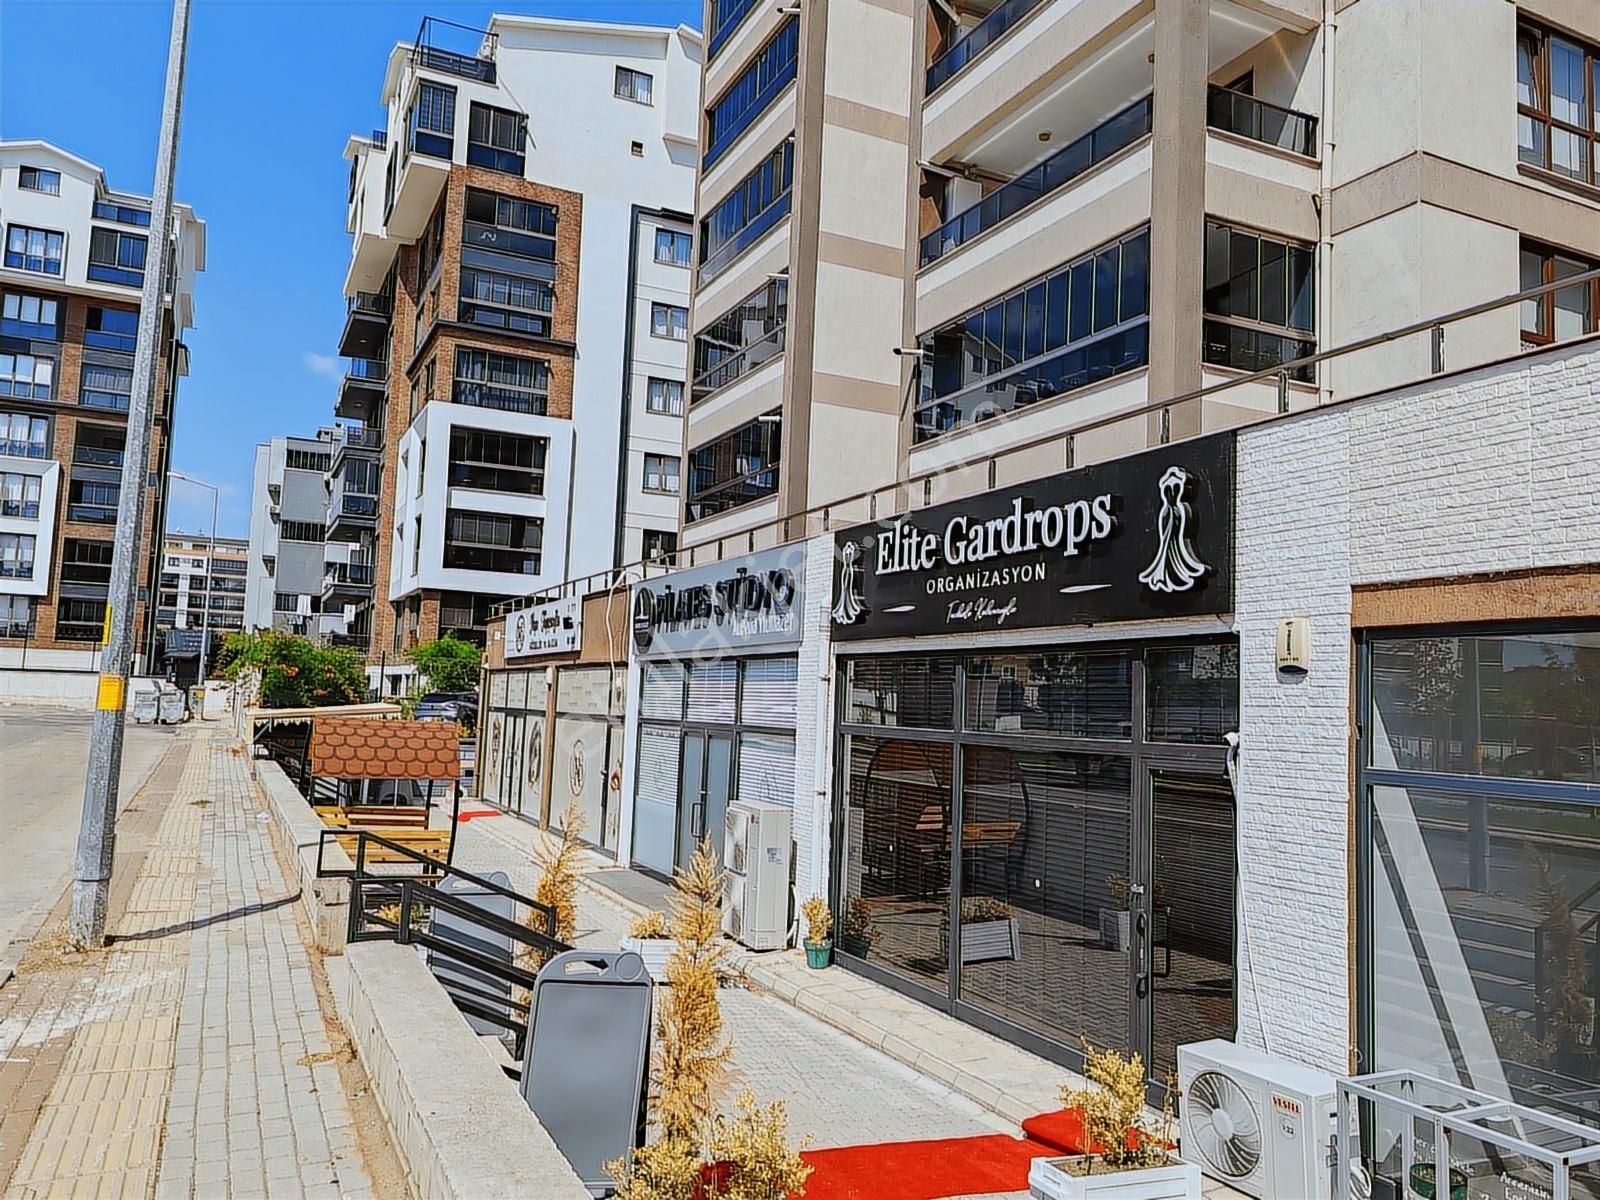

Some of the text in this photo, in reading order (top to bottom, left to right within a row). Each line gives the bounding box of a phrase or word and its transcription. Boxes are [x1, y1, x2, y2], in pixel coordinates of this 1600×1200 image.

[875, 494, 1112, 575] Elite Gardrops
[926, 562, 1046, 595] ORGANİZASYON
